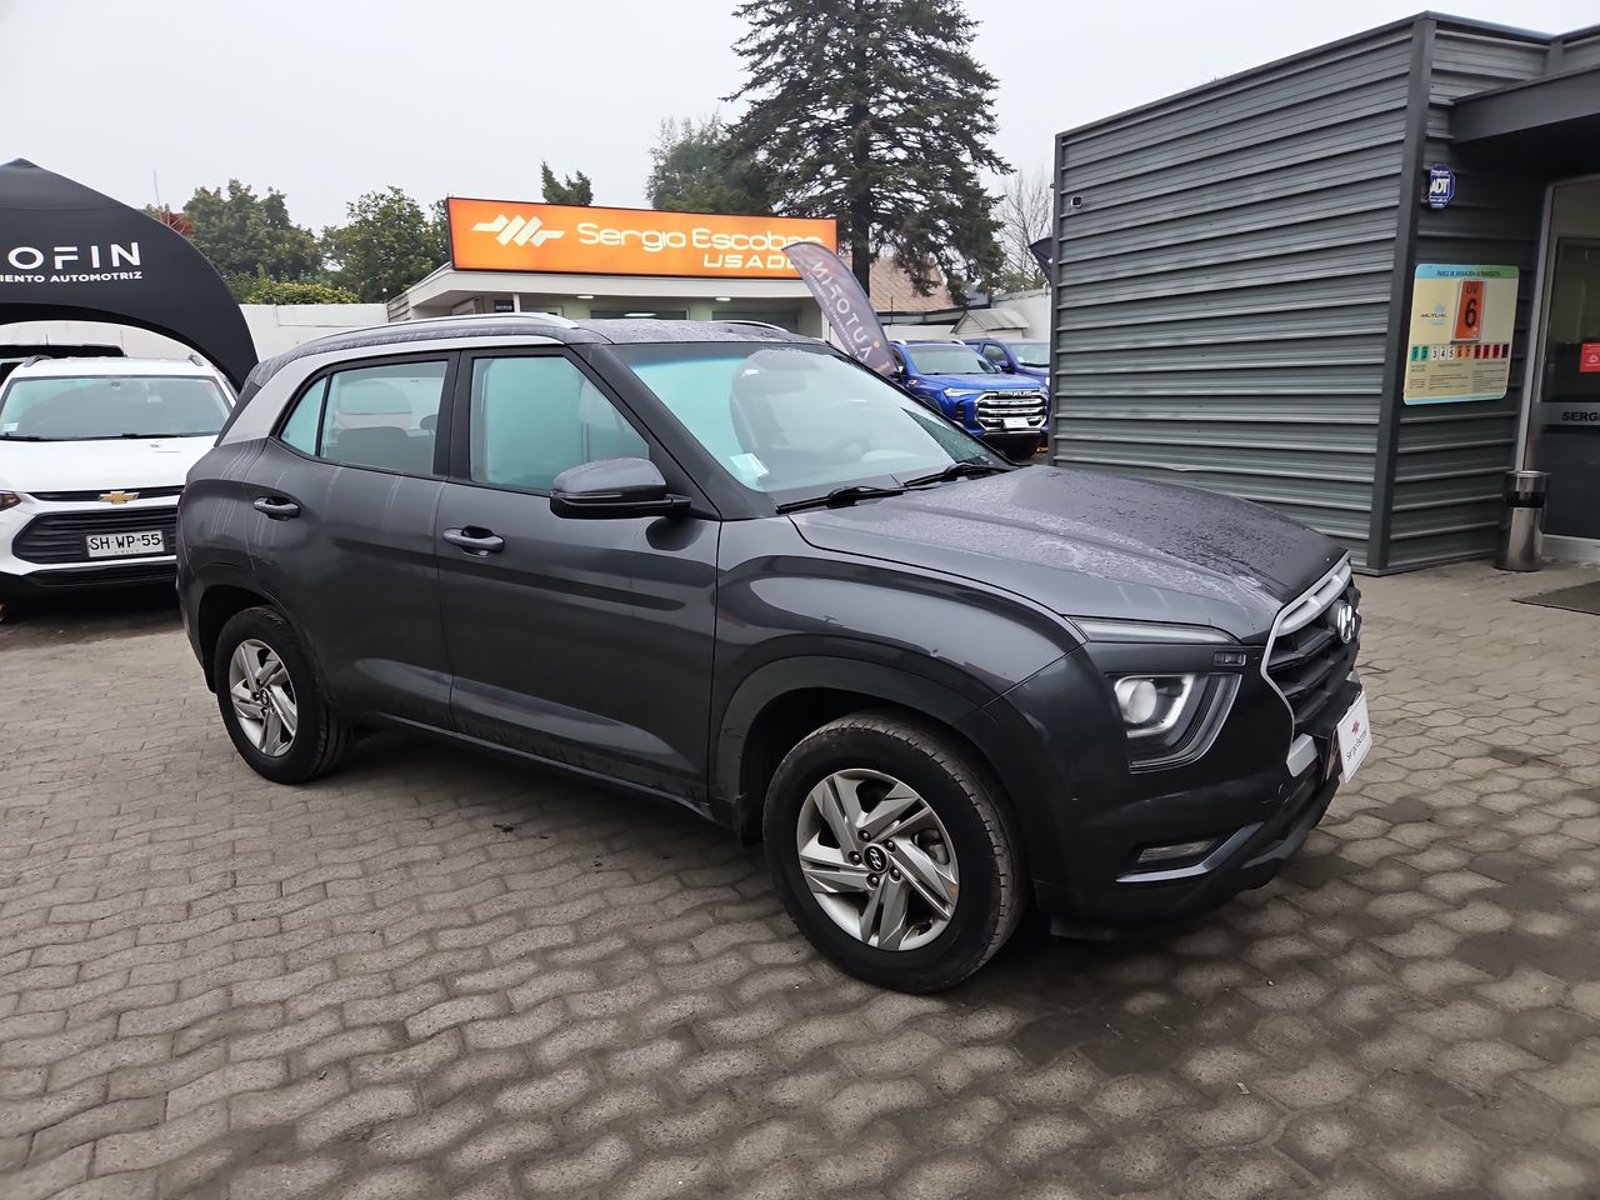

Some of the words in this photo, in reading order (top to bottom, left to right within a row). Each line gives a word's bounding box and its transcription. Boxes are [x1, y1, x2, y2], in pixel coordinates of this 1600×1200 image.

[1430, 178, 1449, 194] ADT
[577, 223, 687, 252] Sergio
[8, 242, 141, 270] OFIN
[50, 271, 143, 283] AUTOMOTRIZ
[1465, 298, 1477, 328] 6
[1562, 411, 1600, 422] SERG
